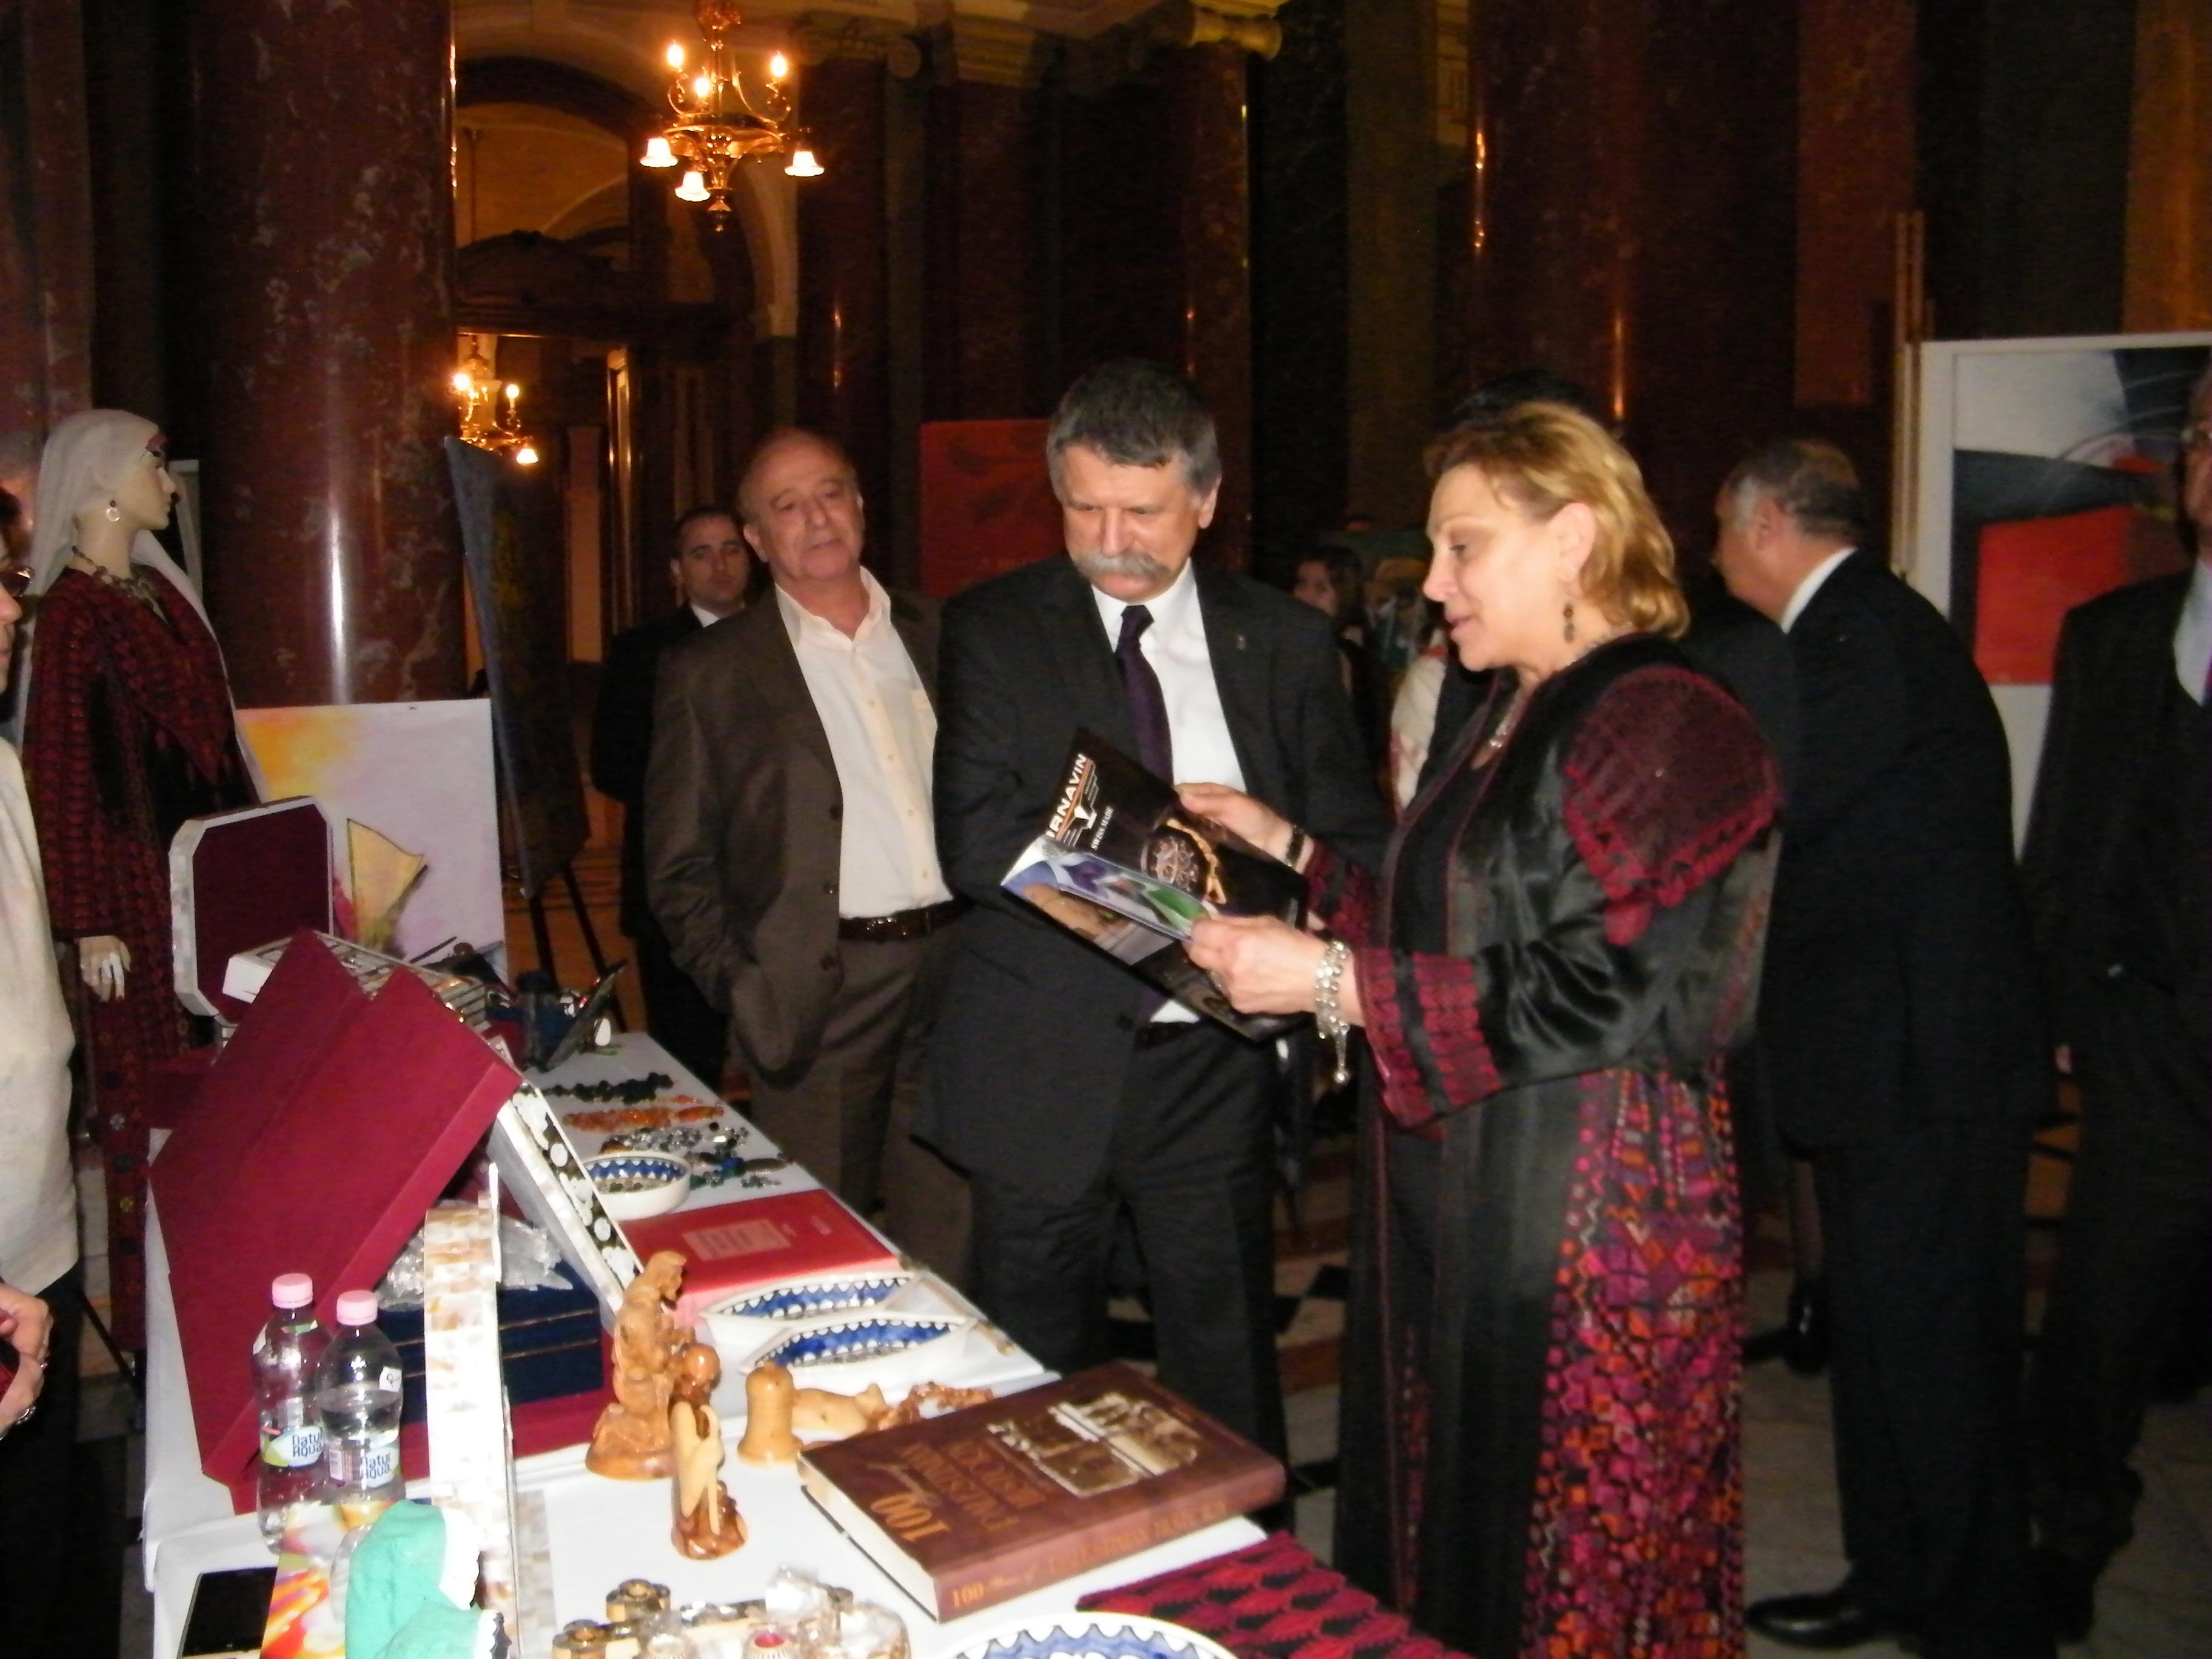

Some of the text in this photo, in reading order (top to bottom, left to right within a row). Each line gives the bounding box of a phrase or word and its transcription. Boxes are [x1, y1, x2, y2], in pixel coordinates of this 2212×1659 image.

[1091, 805, 1114, 850] SWISS MADE
[870, 1493, 951, 1542] 100
